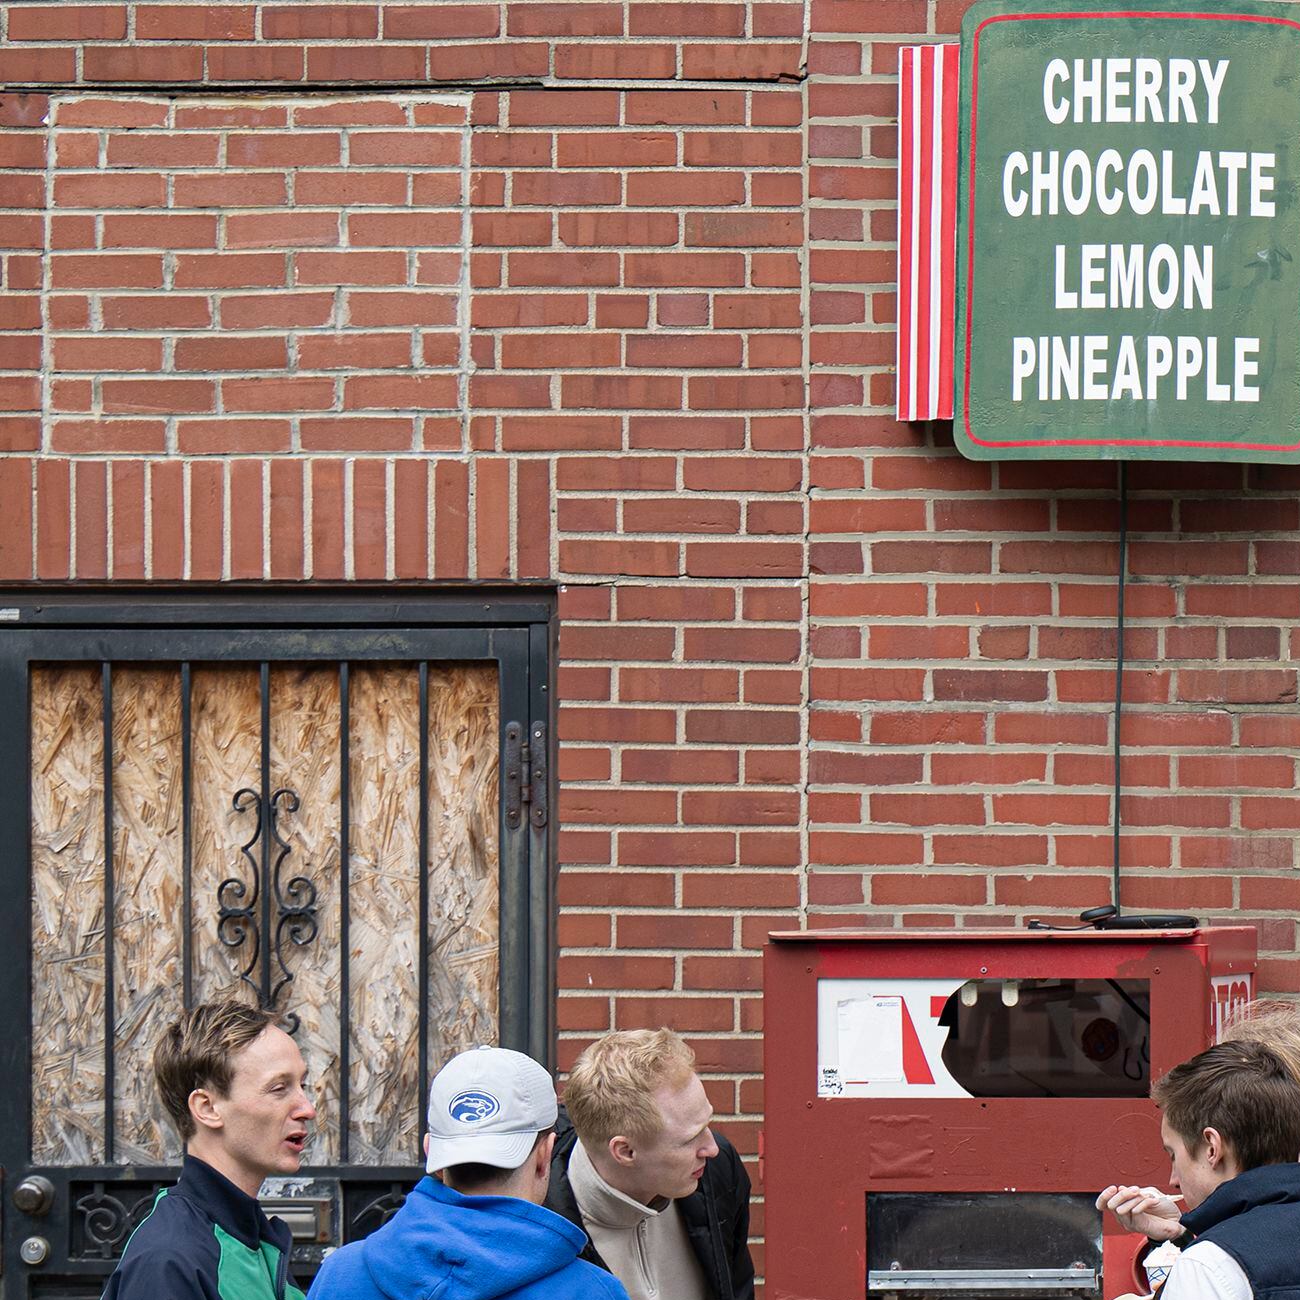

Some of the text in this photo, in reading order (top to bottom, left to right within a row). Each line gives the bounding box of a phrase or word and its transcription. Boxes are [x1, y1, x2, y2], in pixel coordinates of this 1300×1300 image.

[1044, 58, 1229, 124] CHERRY
[1003, 149, 1275, 217] CHOCOLATE
[1056, 244, 1213, 309] LEMON
[1013, 336, 1259, 401] PINEAPPLE
